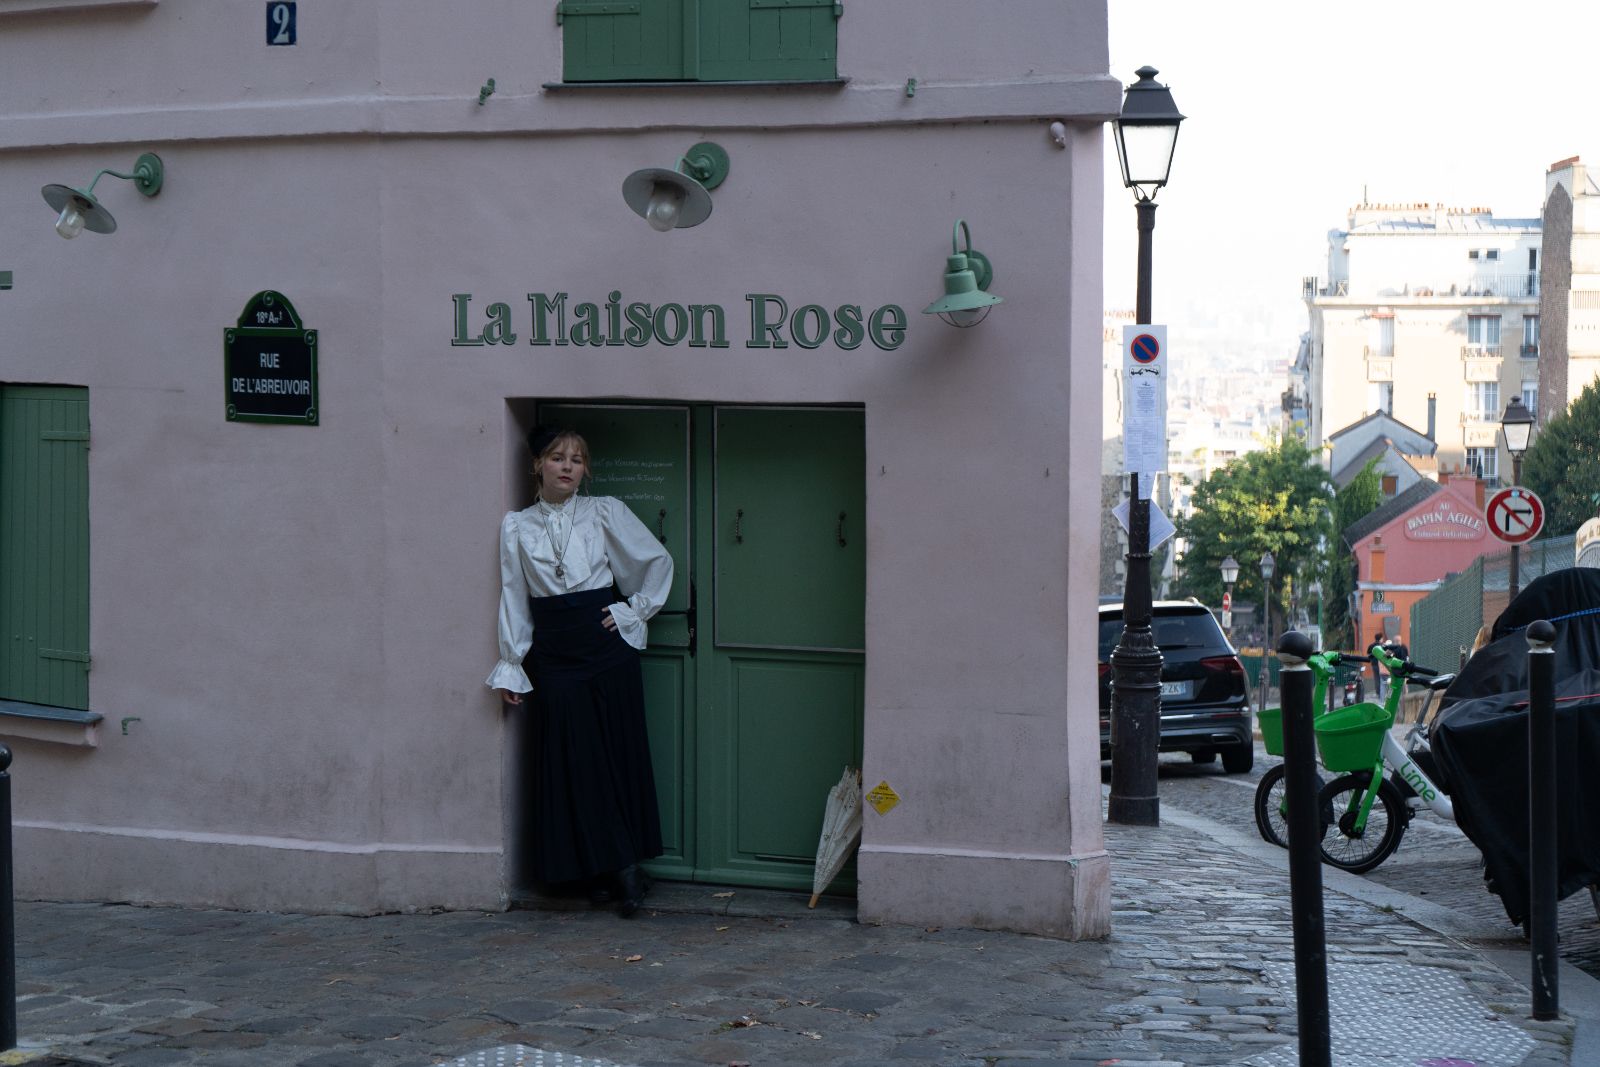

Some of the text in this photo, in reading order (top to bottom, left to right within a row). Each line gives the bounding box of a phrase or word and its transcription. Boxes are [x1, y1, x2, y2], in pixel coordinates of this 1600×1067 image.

[273, 4, 289, 44] 2
[451, 290, 908, 351] La Maison Rose
[260, 353, 280, 368] RUE
[232, 378, 310, 395] DE L'ABREUVOIR
[1439, 502, 1450, 511] AU
[1446, 511, 1483, 531] AGILE
[1400, 761, 1436, 803] Lime
